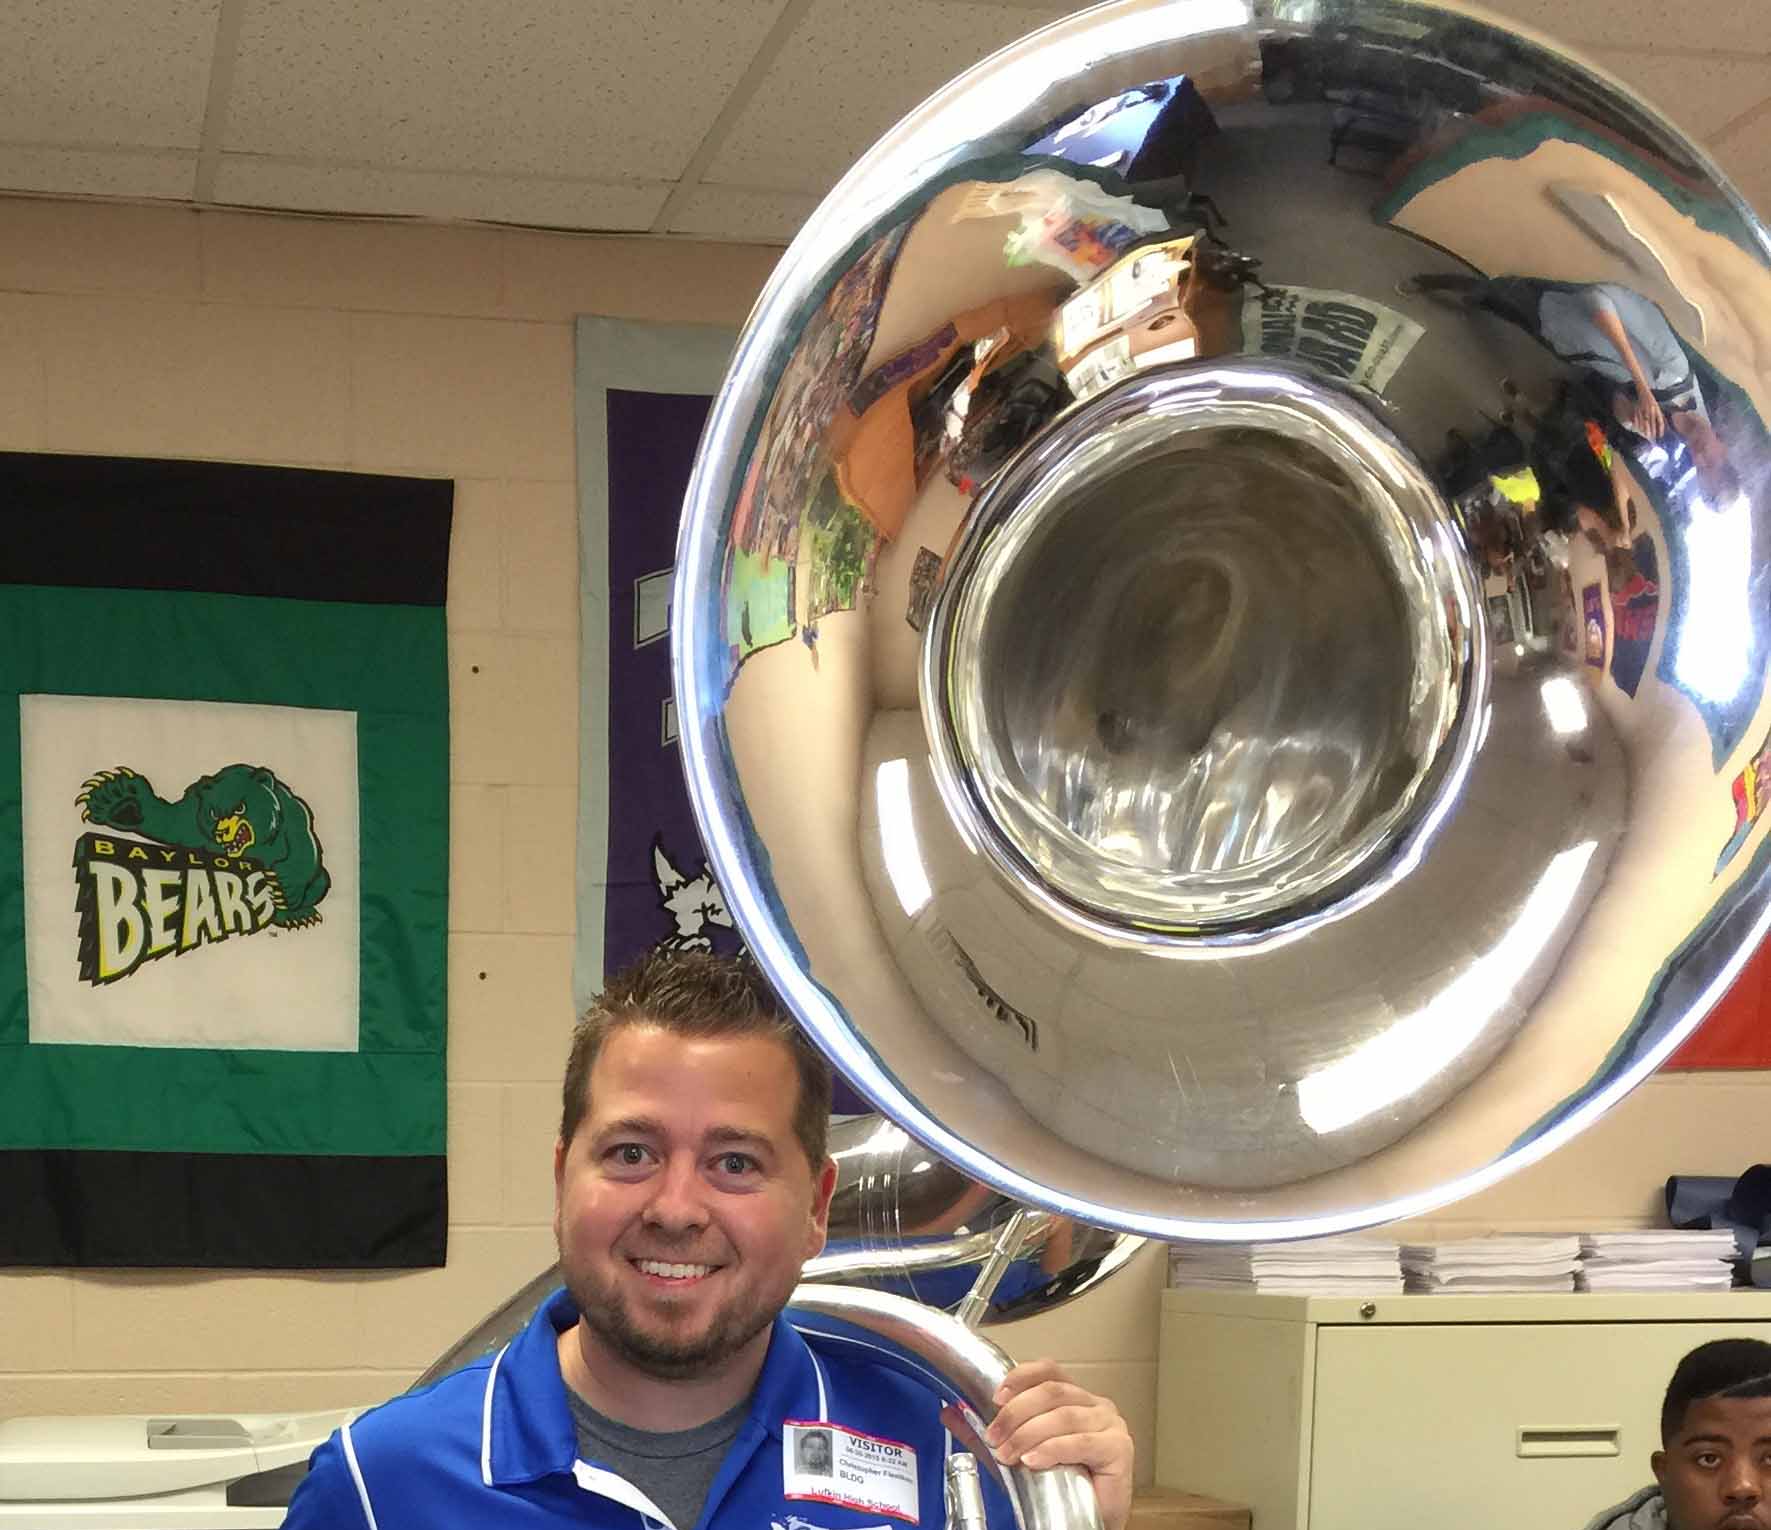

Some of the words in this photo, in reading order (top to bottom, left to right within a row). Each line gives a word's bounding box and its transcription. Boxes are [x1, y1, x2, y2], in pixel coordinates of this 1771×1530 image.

[94, 839, 253, 871] BAYLOR
[88, 860, 276, 979] BEARS
[849, 1436, 902, 1457] VISITOR
